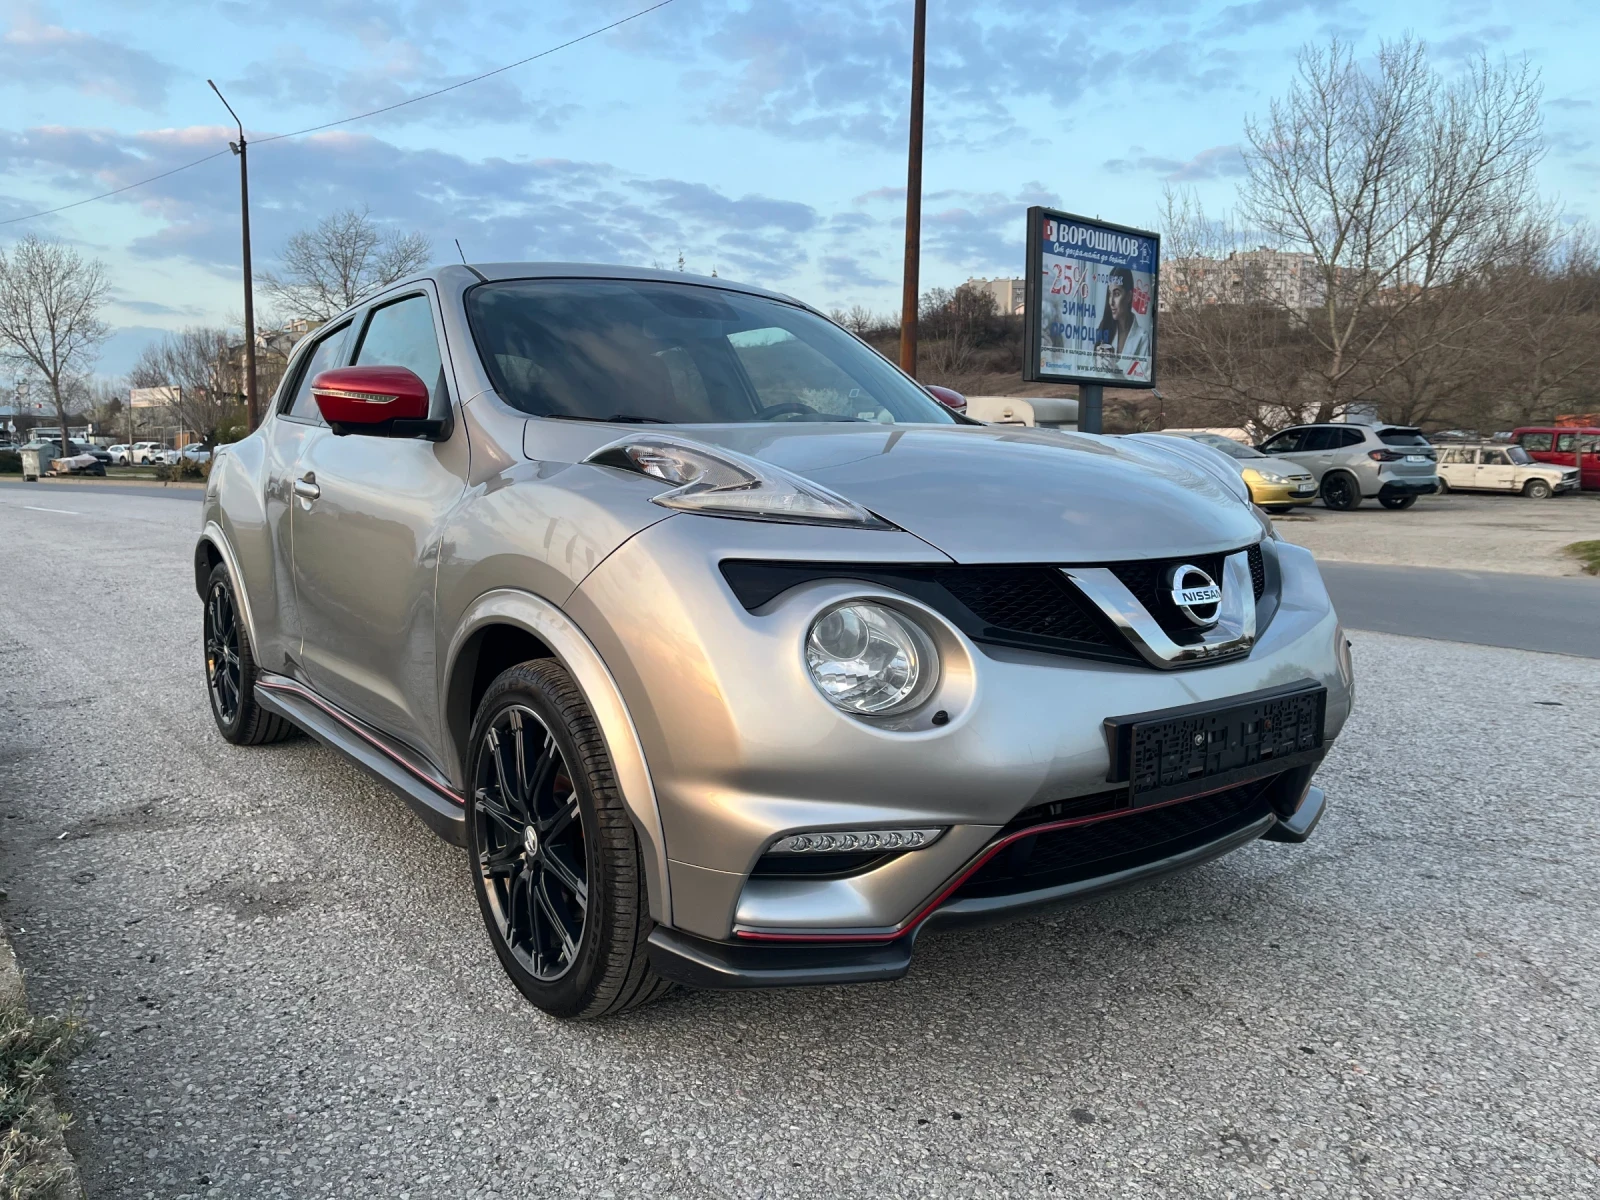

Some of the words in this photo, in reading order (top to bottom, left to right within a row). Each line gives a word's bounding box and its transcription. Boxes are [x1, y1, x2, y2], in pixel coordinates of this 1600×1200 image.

[1059, 223, 1139, 257] ВОРОШИЛОВ
[1062, 299, 1097, 319] ЗИМНА
[1051, 321, 1110, 345] ПРОМОЦИЯ
[1181, 589, 1222, 602] NISSAN
